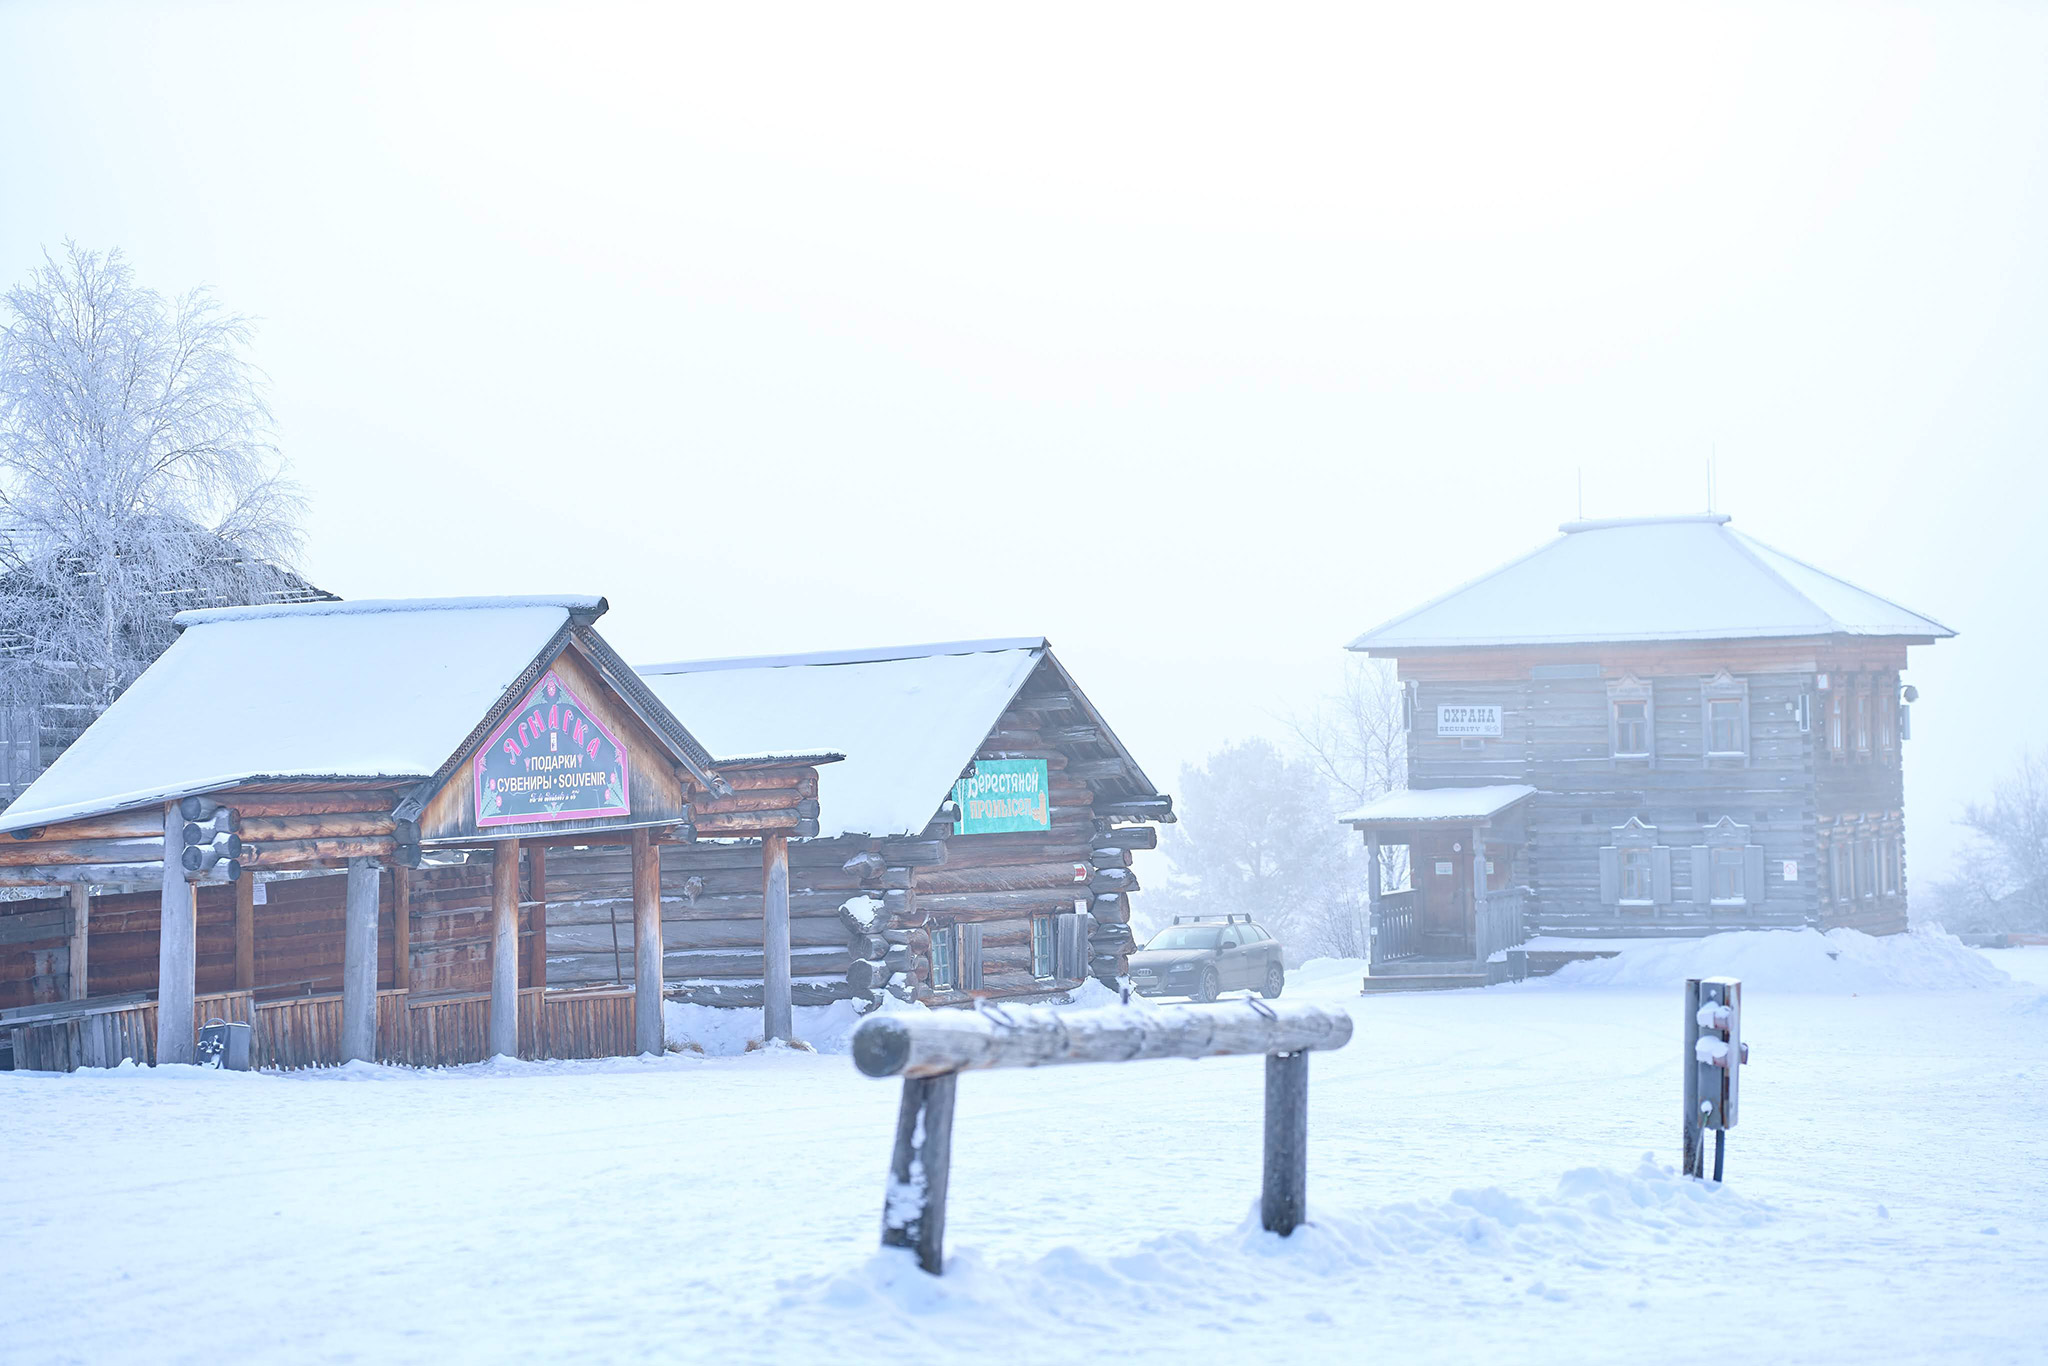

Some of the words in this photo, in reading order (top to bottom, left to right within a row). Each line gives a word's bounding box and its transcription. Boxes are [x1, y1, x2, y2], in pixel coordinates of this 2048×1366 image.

[1443, 708, 1496, 723] ОХРАНА
[531, 754, 578, 772] ПОДАРКИ
[497, 775, 552, 793] СУВЕНИРЫ
[558, 771, 607, 788] SOUVENIR
